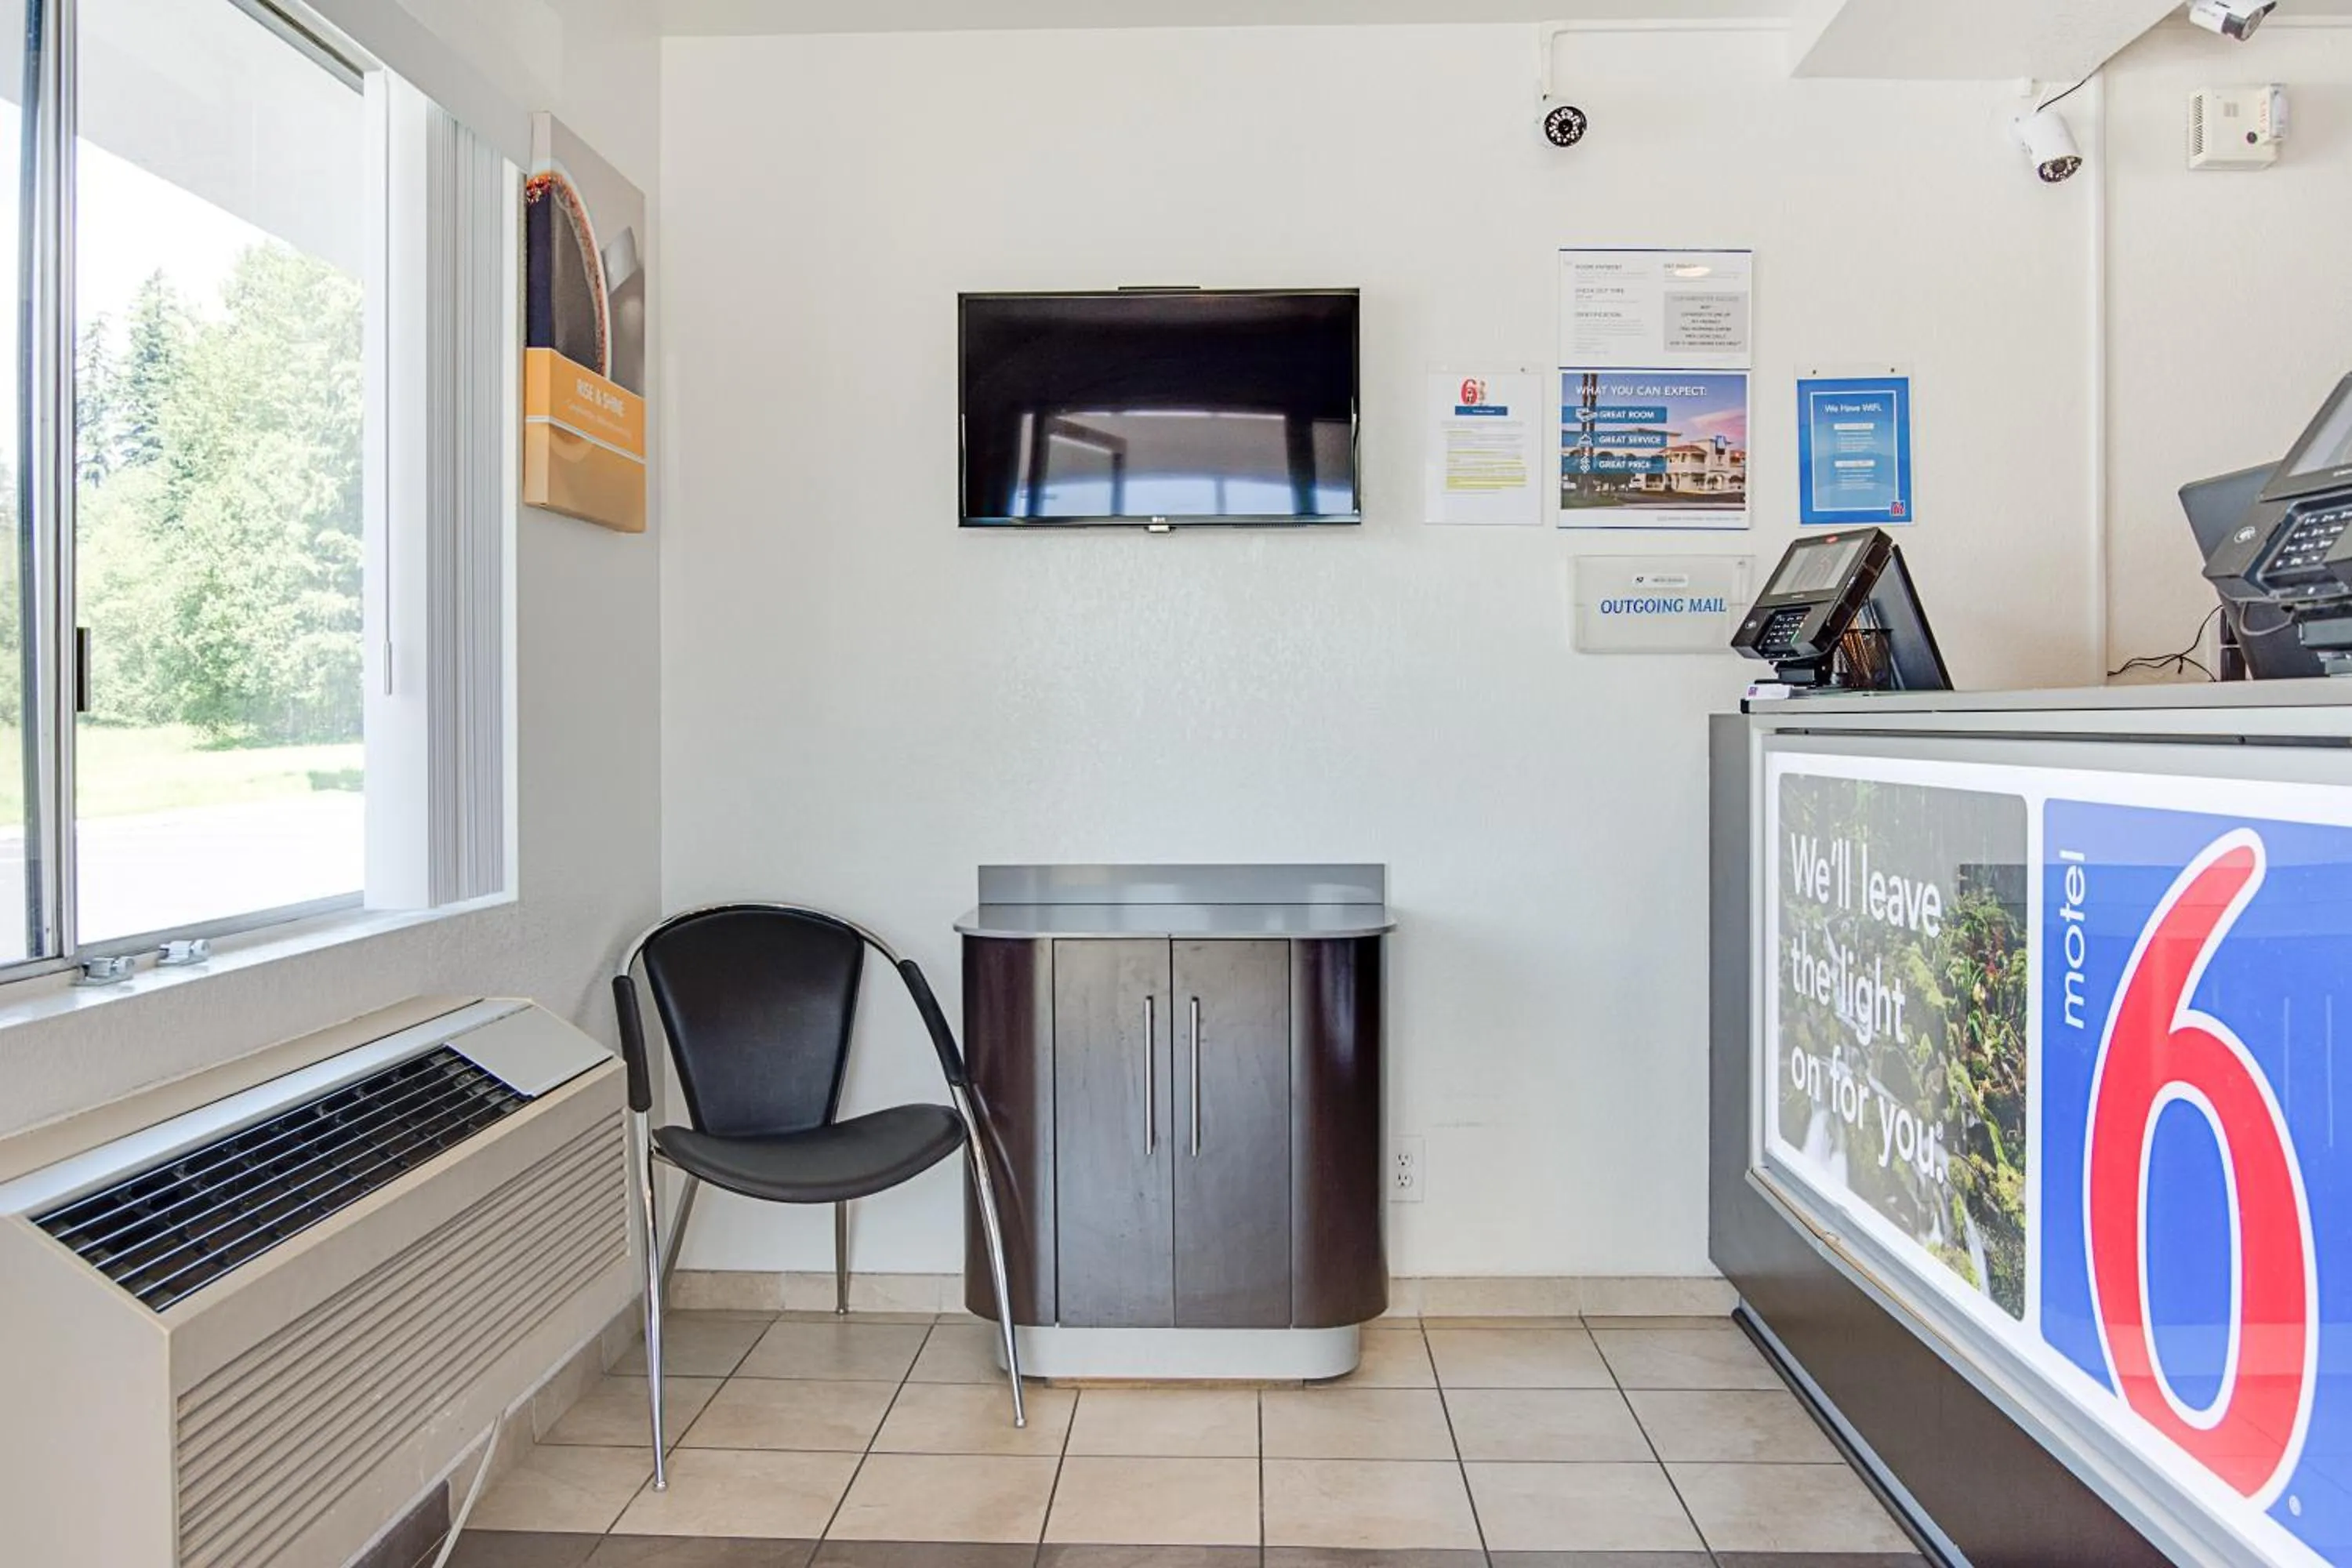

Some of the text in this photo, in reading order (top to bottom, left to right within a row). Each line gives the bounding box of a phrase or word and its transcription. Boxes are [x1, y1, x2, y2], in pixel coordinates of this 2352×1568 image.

[1575, 386, 1707, 397] WHAT YOU CAN EXPECT:
[1599, 410, 1654, 419] GREAT ROOM
[1599, 435, 1661, 444] GREAT SERVICE
[1599, 460, 1651, 469] GREAT PRICE
[1600, 597, 1727, 614] OUTGOING MAIL
[1791, 833, 1942, 938] We'll leave
[2061, 849, 2085, 1029] motel
[1791, 930, 1906, 1045] the light
[1791, 1046, 1820, 1101] on
[1829, 1045, 1869, 1130] for
[2082, 826, 2319, 1512] 6
